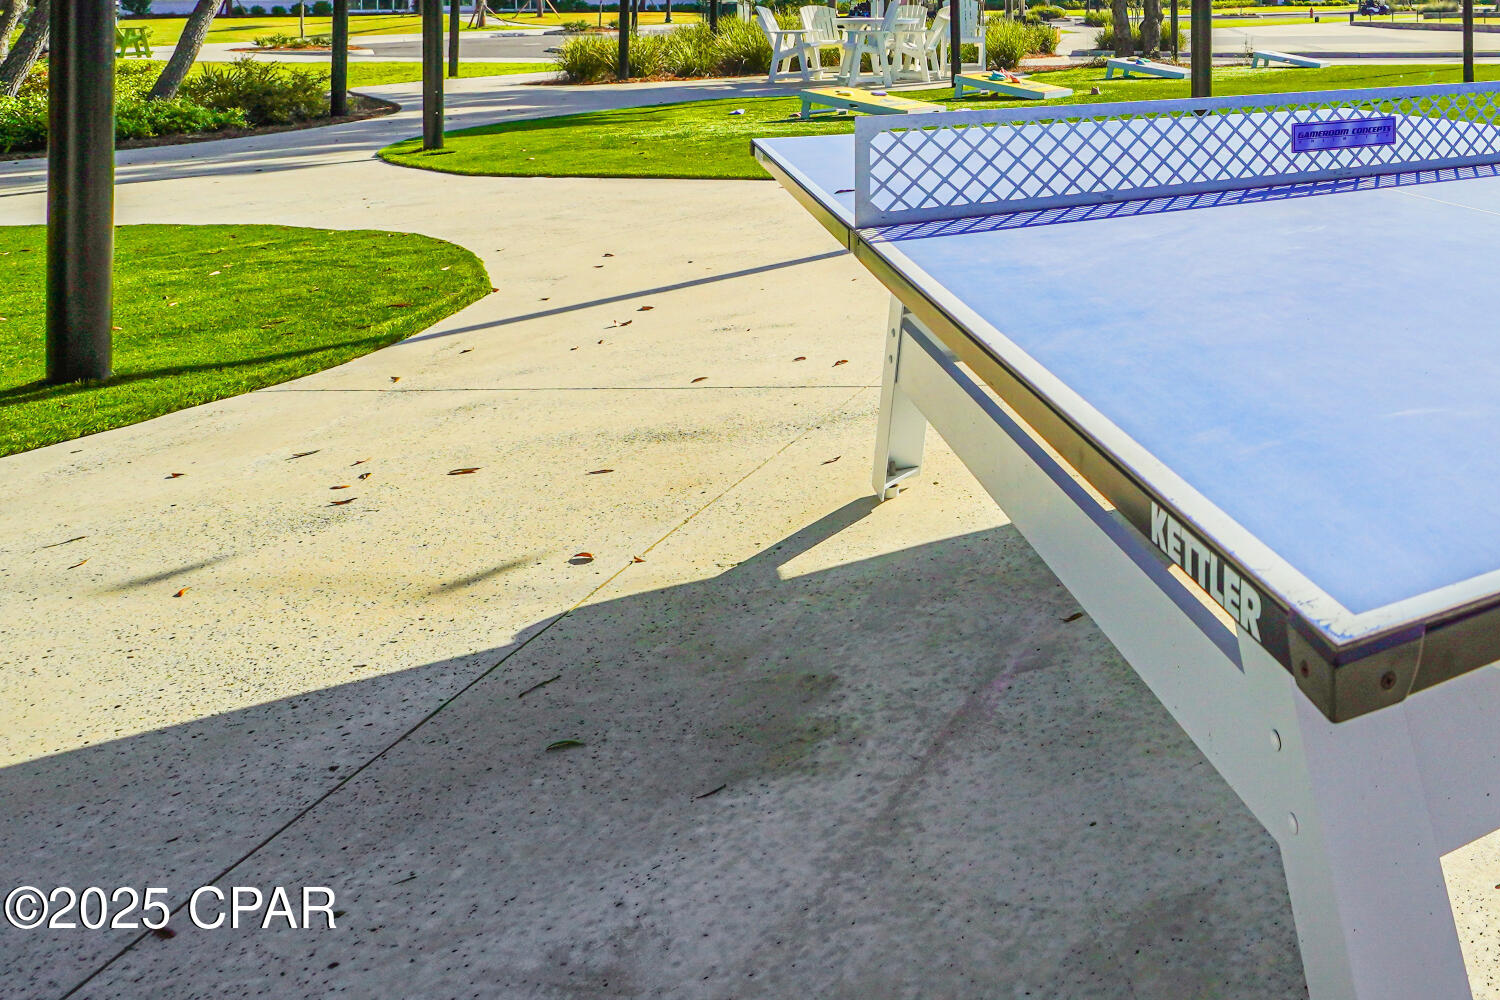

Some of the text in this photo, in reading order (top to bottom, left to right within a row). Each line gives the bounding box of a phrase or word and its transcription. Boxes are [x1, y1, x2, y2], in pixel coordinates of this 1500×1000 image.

[1297, 128, 1350, 139] GAMEROOM
[1351, 125, 1392, 135] CONCEPTS
[1151, 501, 1262, 643] KETTLER
